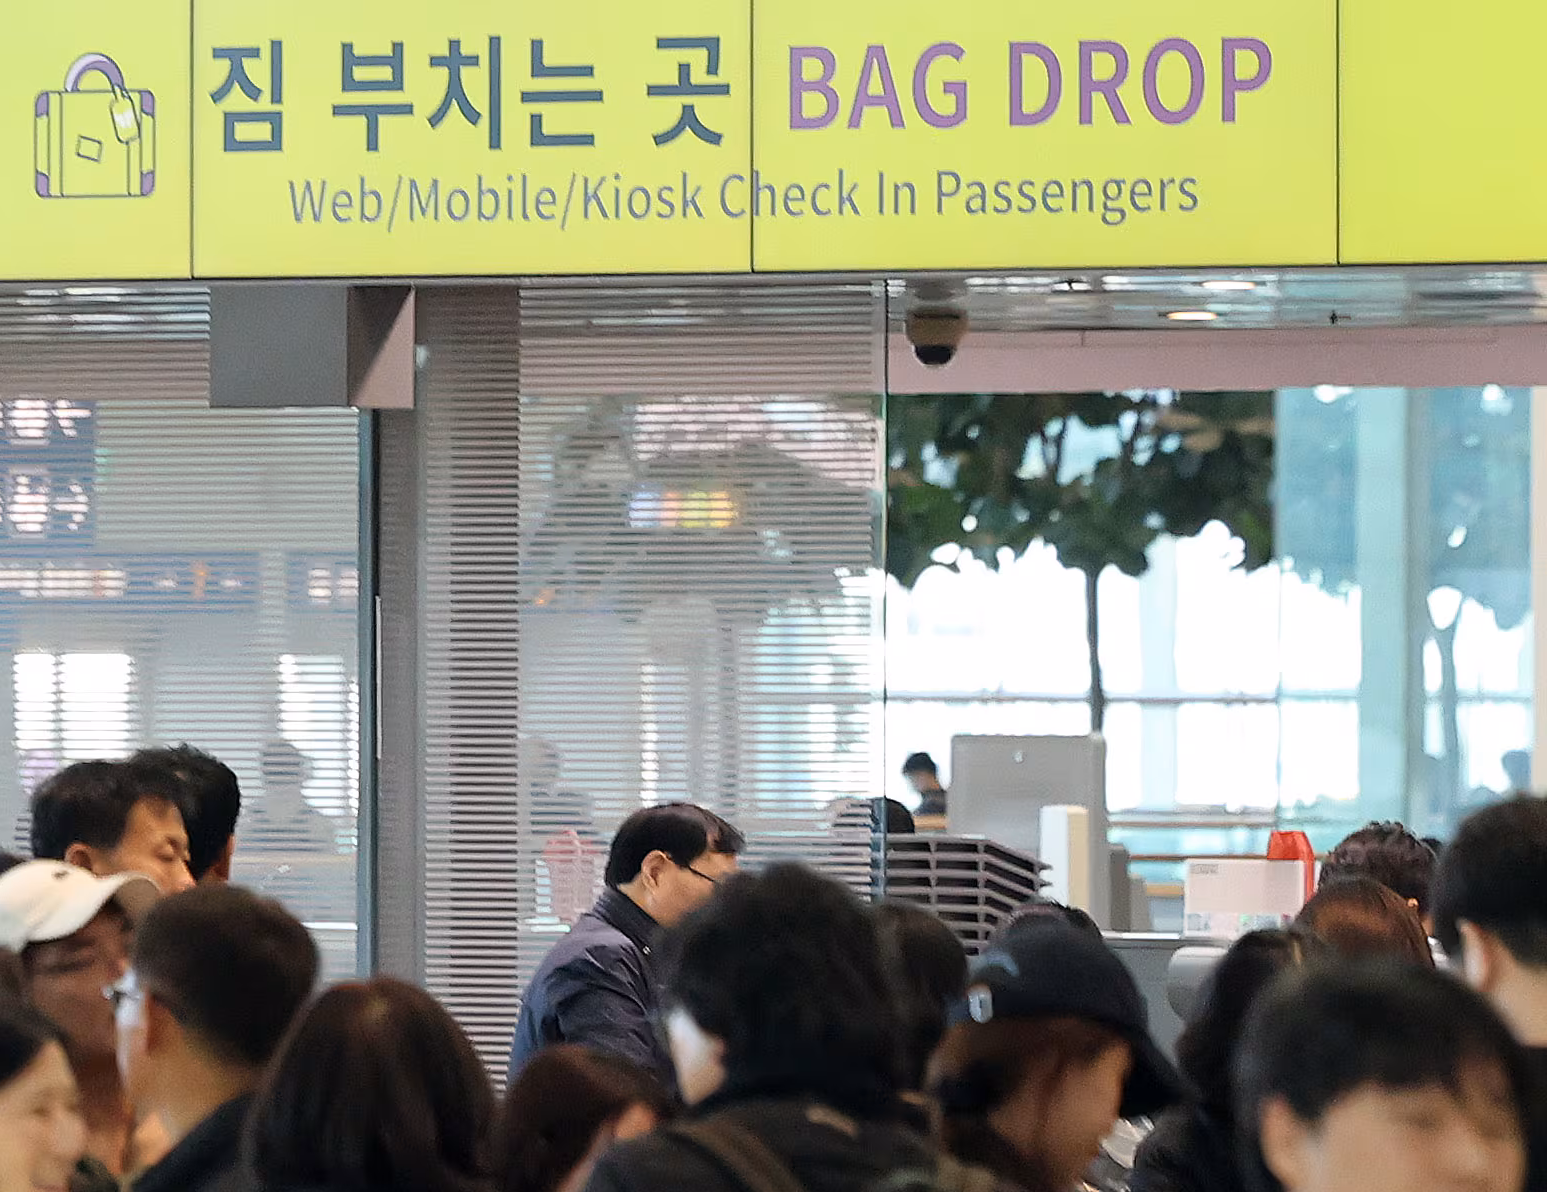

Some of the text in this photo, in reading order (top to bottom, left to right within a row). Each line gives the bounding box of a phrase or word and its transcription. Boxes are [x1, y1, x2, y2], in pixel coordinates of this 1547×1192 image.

[209, 35, 731, 153] 짐 부치는 곳
[788, 36, 1273, 130] BAG DROP
[289, 168, 1199, 233] Web/Mobile/Kiosk Check In Passengers
